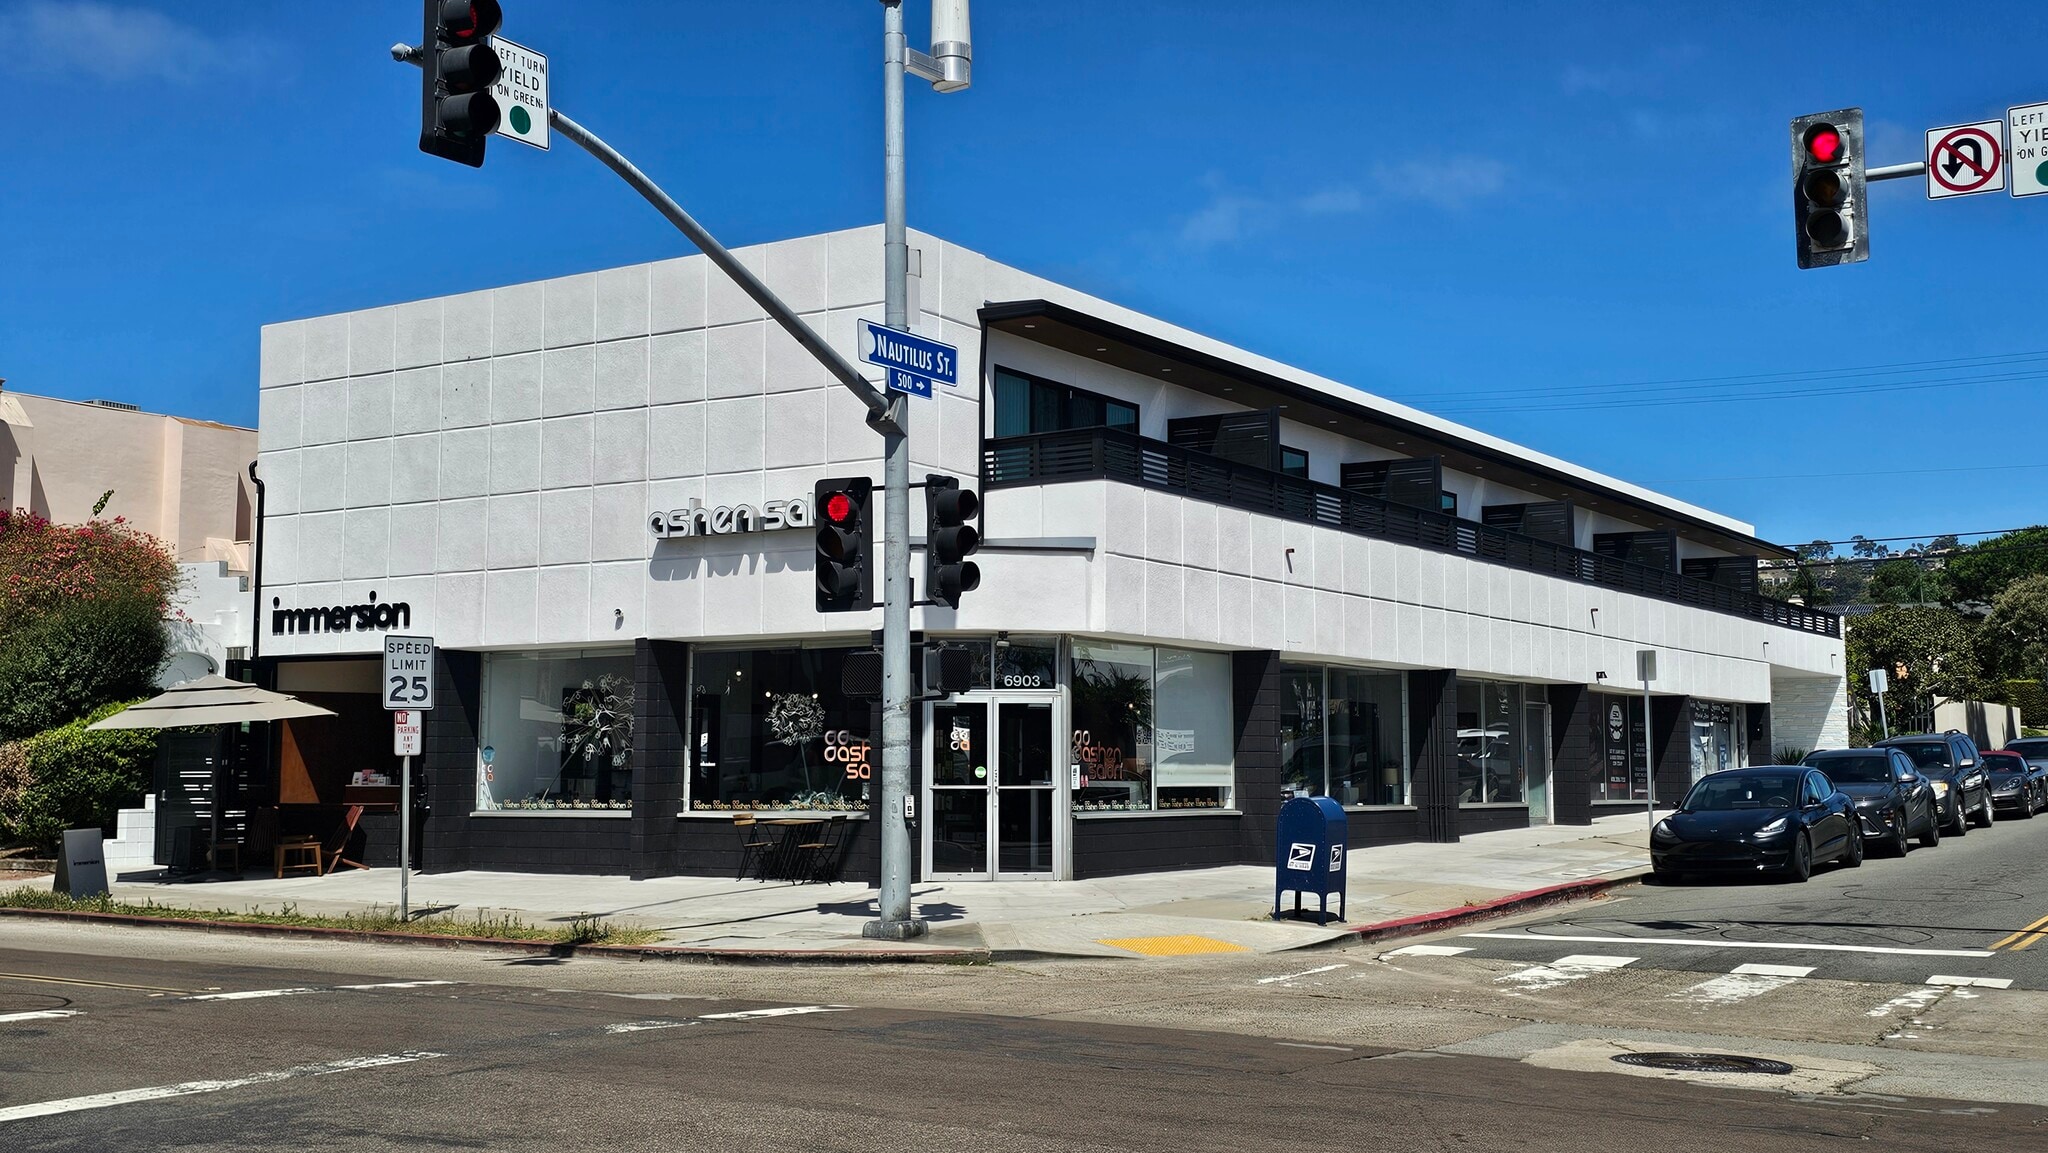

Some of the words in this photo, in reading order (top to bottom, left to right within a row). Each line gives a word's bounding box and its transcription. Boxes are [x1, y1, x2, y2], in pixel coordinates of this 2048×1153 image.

[521, 56, 545, 75] TURN
[501, 66, 539, 91] YIELD
[498, 83, 509, 97] ON
[514, 89, 541, 109] GREEN
[2012, 112, 2043, 127] LEFT
[2020, 127, 2048, 144] YIE
[2019, 148, 2034, 160] ON
[877, 334, 932, 371] NAUTILUS
[937, 351, 953, 376] ST.
[897, 372, 913, 390] 500
[647, 498, 757, 538] ashen
[763, 492, 816, 530] sal
[272, 590, 411, 635] immersion
[388, 642, 430, 655] SPEED
[392, 660, 426, 671] LIMIT
[389, 675, 428, 702] 25
[1004, 674, 1040, 687] 6903
[396, 712, 406, 724] NO
[397, 726, 419, 734] PARKING
[1082, 740, 1122, 762] ashen
